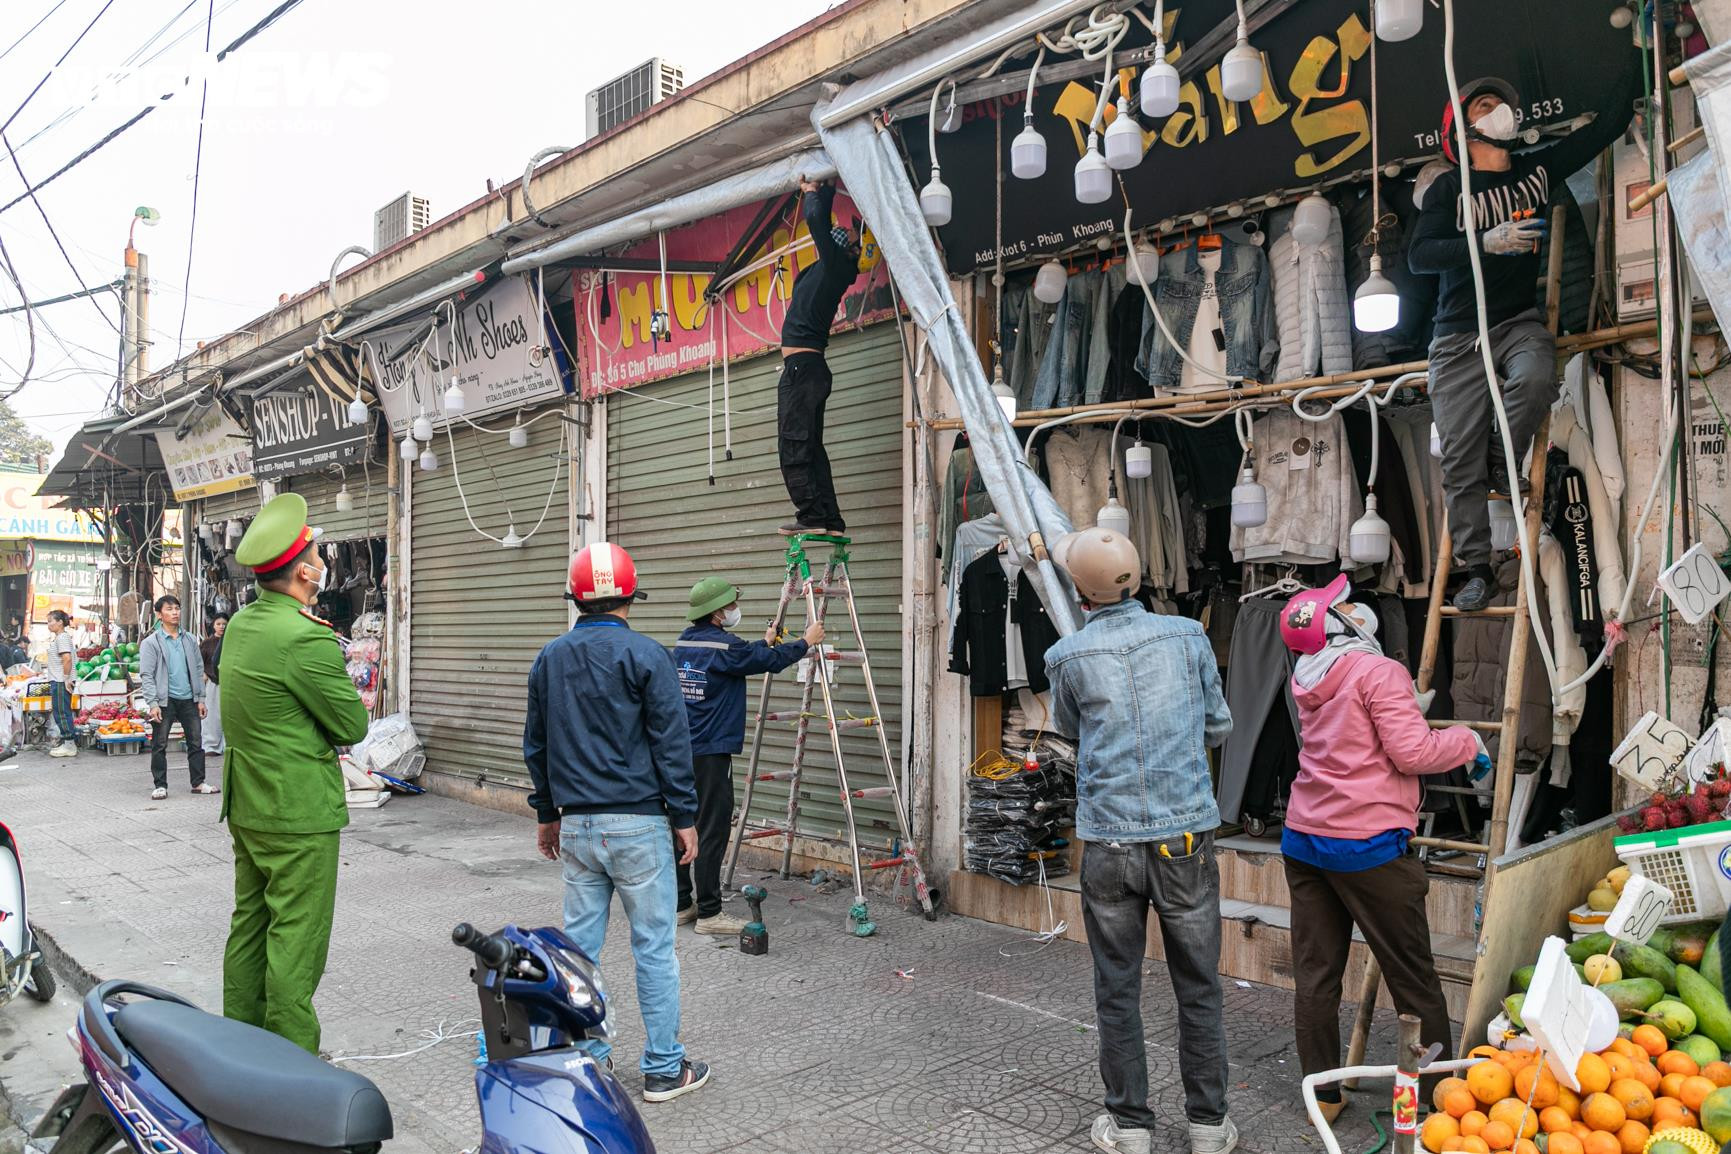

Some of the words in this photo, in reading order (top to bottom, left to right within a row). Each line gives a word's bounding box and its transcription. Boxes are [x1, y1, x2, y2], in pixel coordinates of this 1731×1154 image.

[1020, 240, 1027, 252] 6
[1072, 218, 1114, 239] Khoang
[476, 300, 528, 360] Shoes
[620, 364, 626, 380] 5
[647, 351, 677, 373] Phùng
[679, 339, 716, 364] Khoang
[253, 384, 320, 450] SENSHOP
